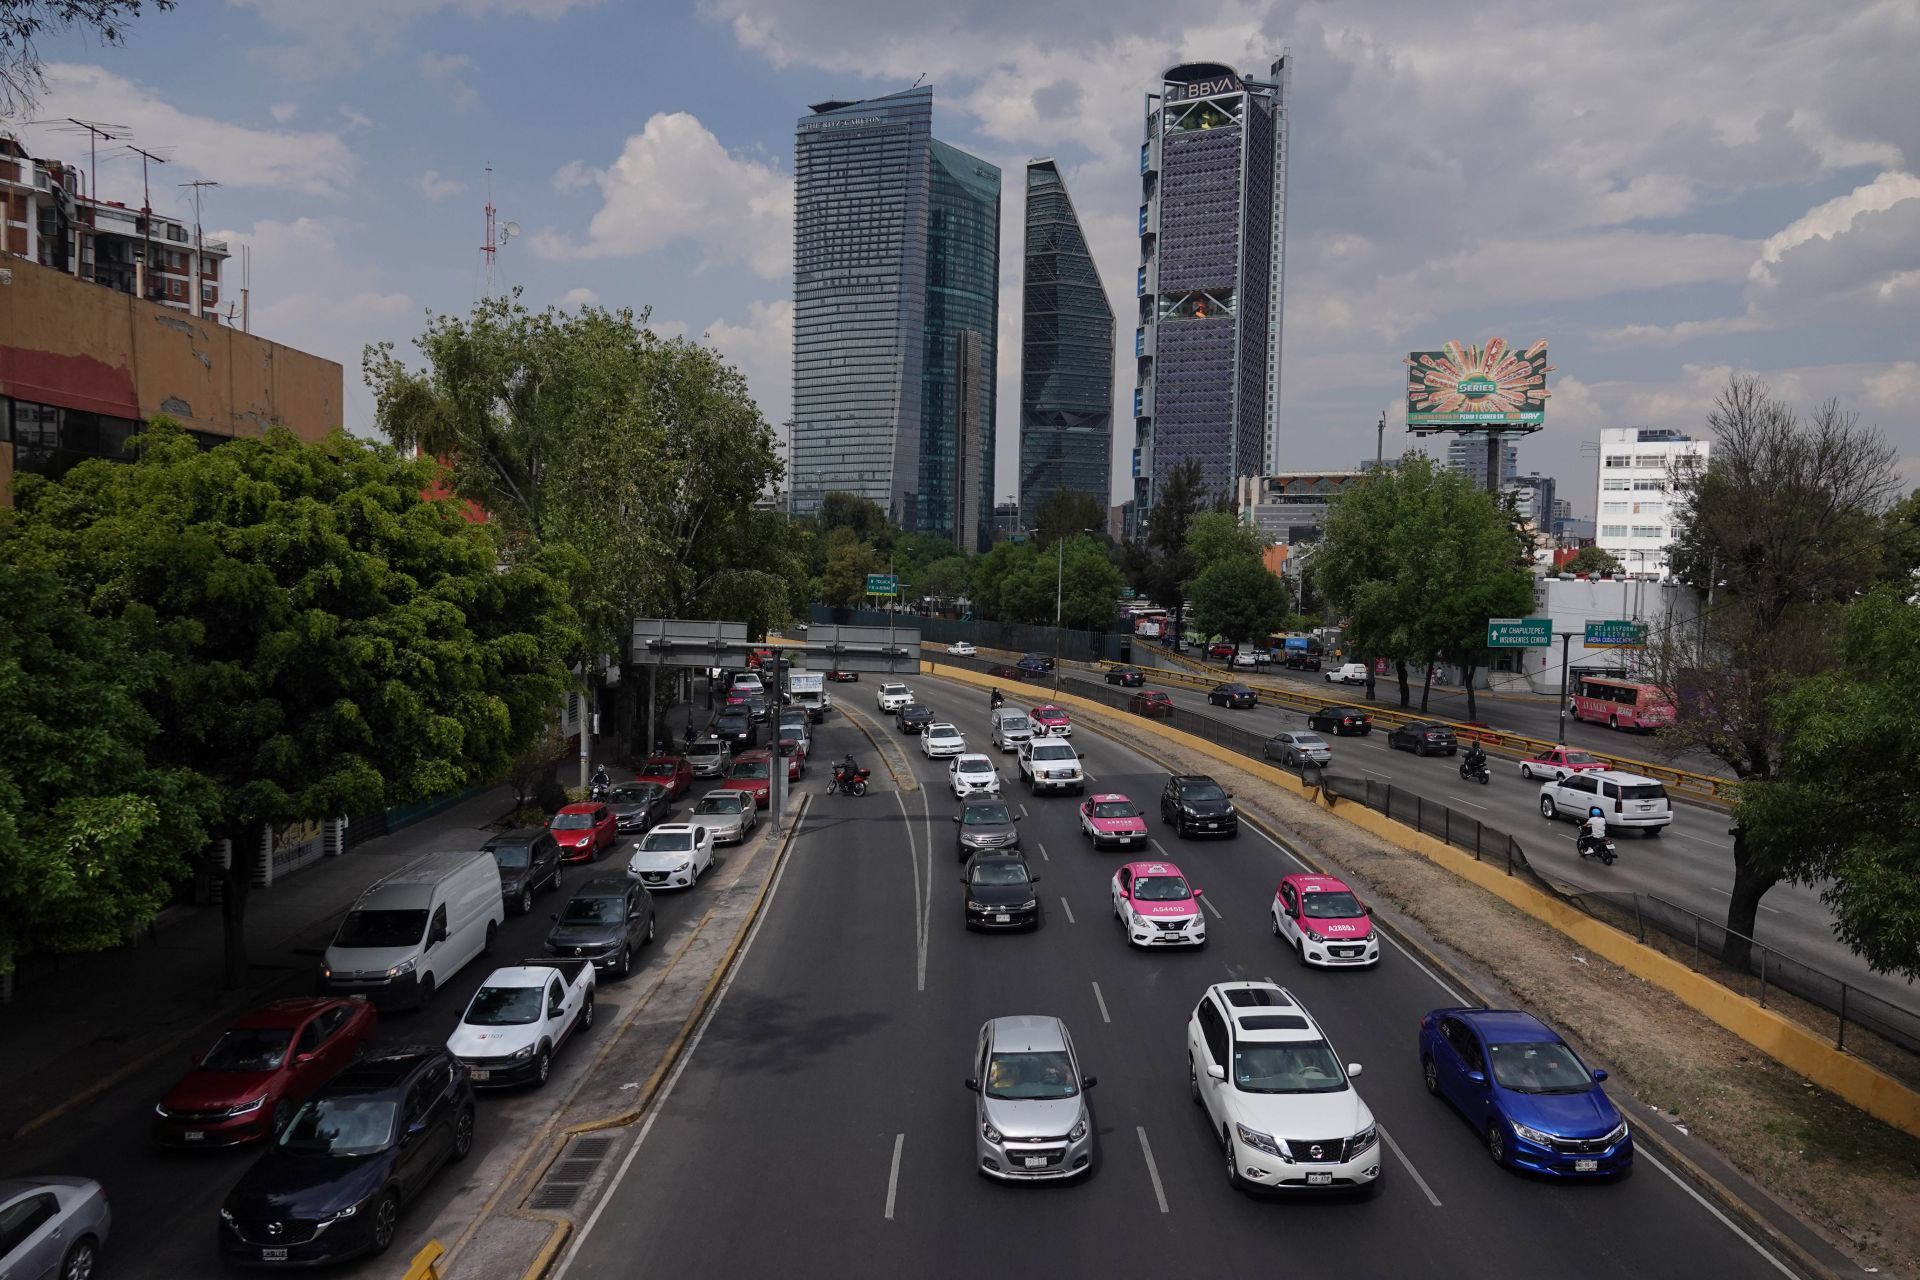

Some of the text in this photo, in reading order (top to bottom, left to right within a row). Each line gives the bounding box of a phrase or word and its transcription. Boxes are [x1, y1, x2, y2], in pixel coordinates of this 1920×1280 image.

[1188, 78, 1233, 98] BBVA
[1459, 384, 1495, 392] SERIES
[1508, 627, 1545, 635] CHAPULTEPEC
[1499, 636, 1529, 644] INSURGENTES
